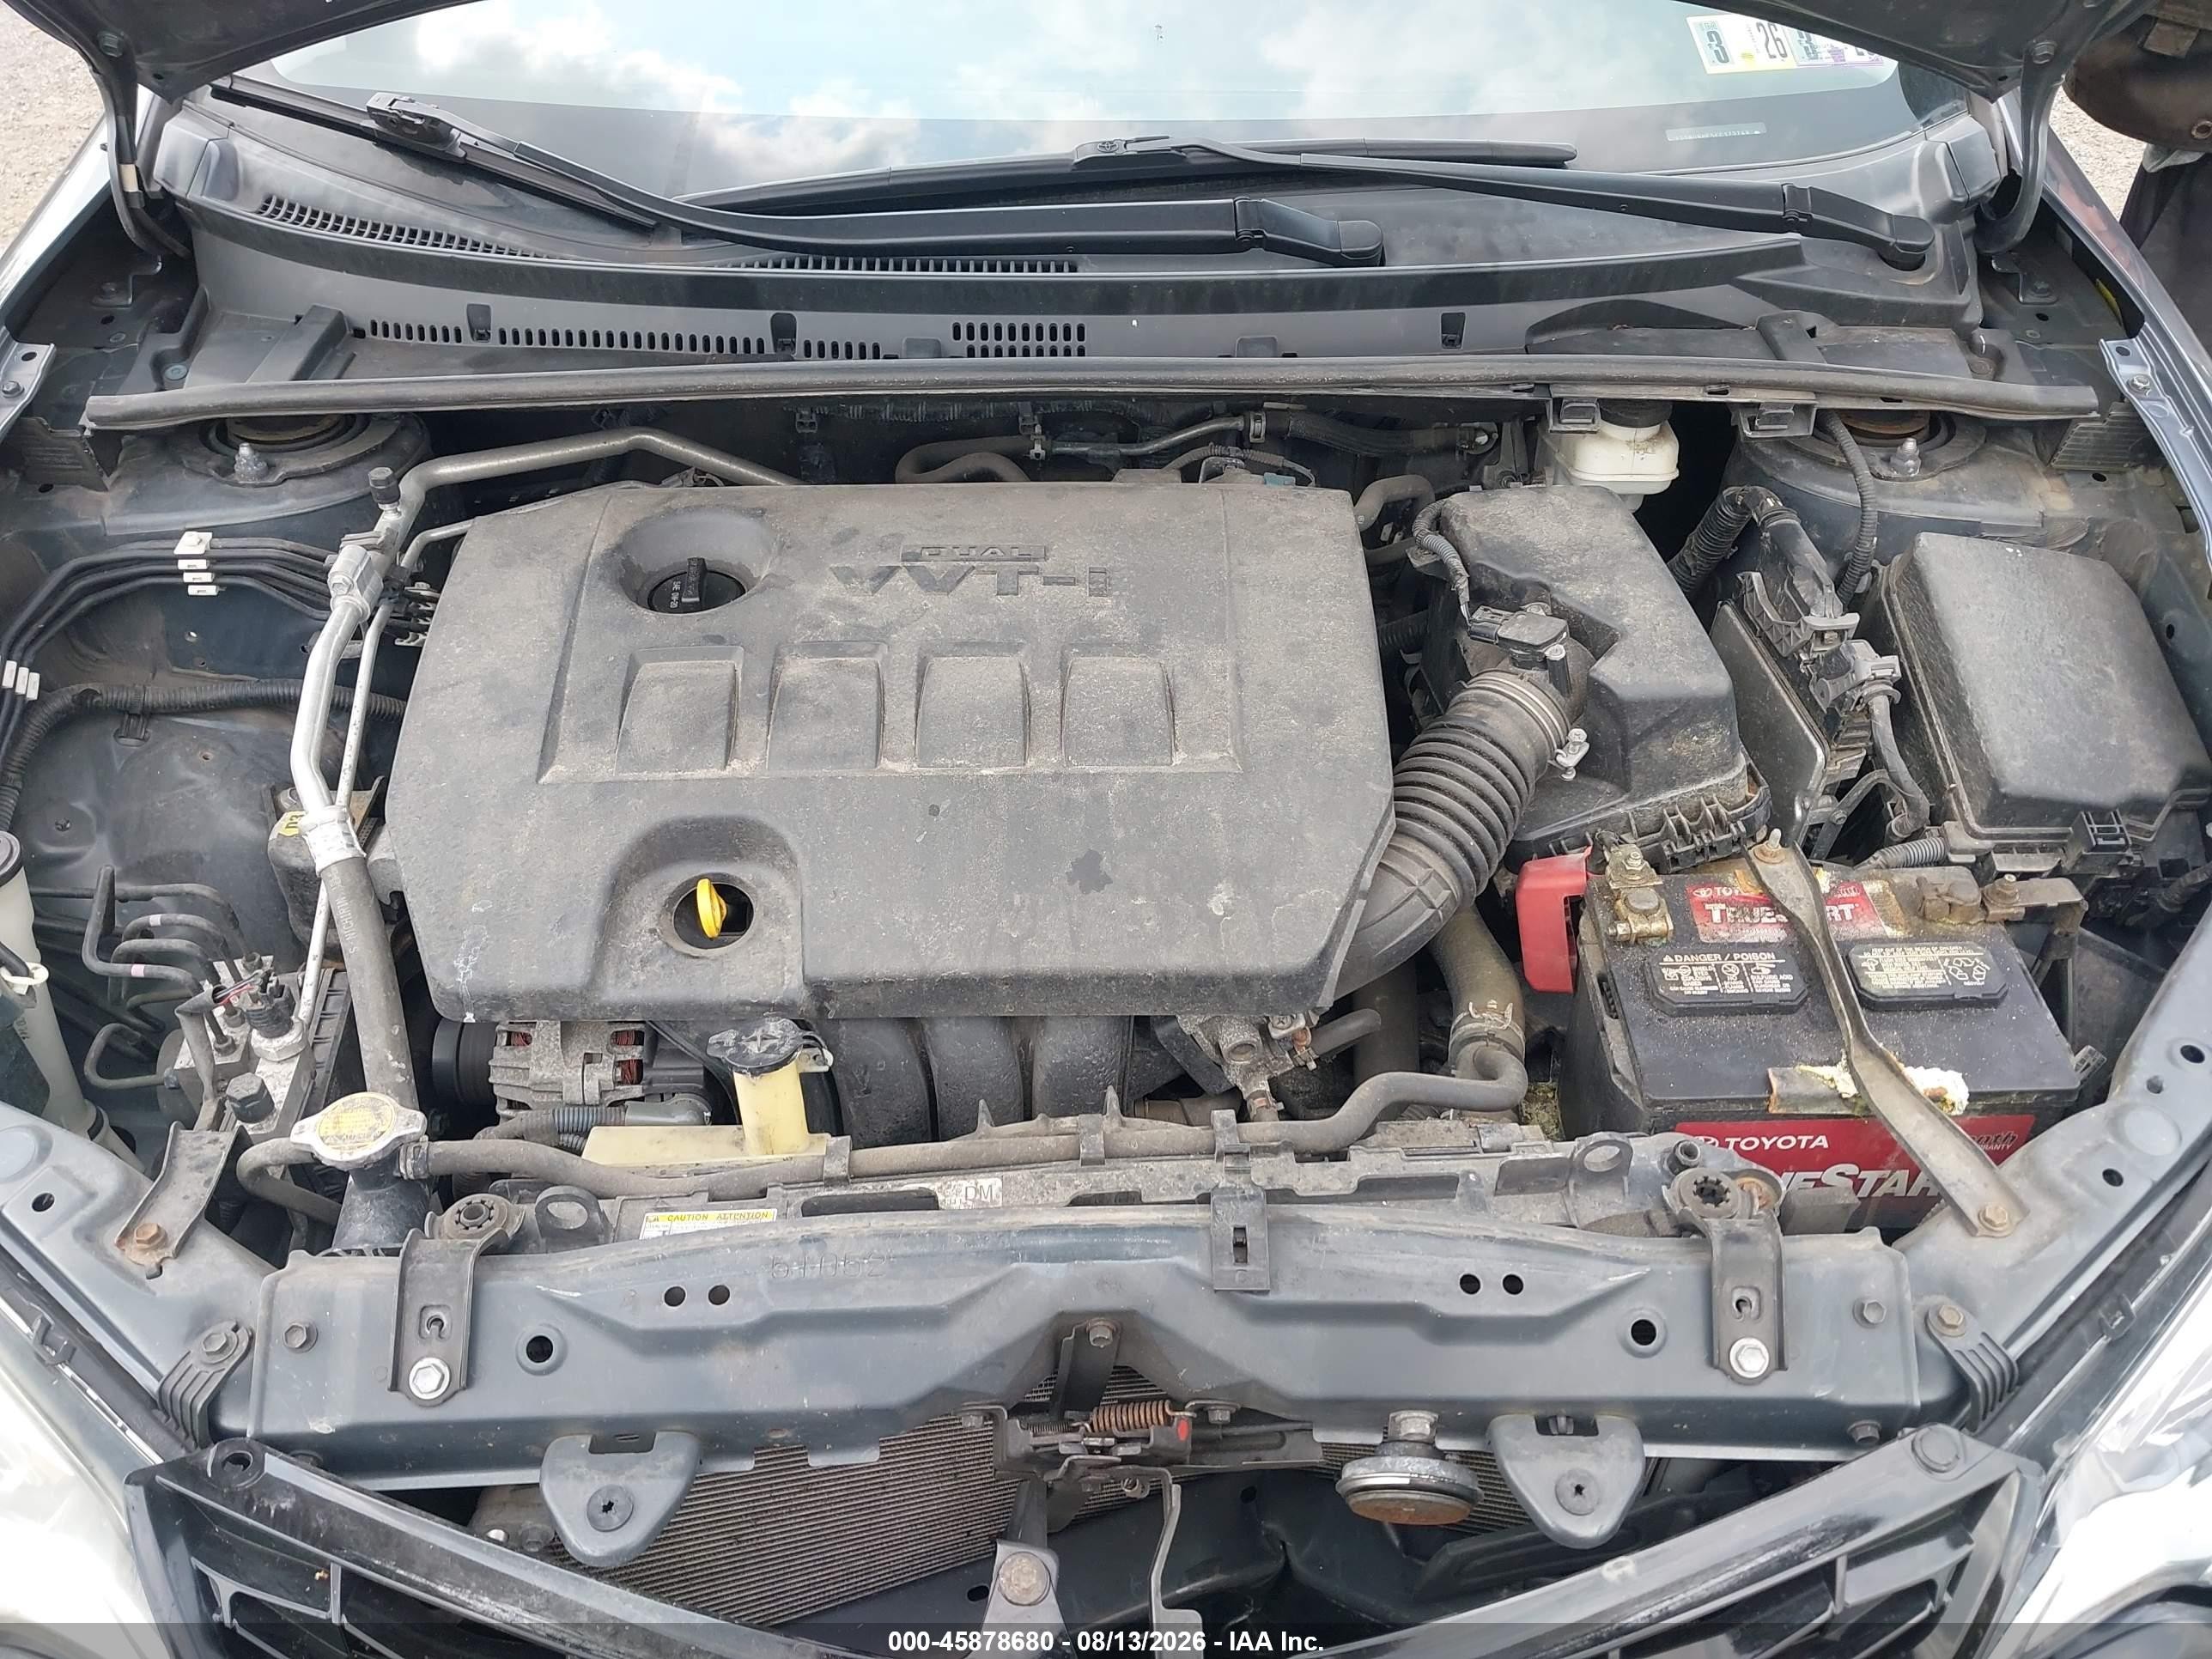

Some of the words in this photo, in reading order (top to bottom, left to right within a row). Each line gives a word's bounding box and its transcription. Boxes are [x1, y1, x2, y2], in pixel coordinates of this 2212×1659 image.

[1756, 21, 1788, 58] 26
[1724, 1135, 1830, 1151] TOYOTA
[965, 1185, 994, 1204] DM
[667, 1213, 709, 1222] CAUTION
